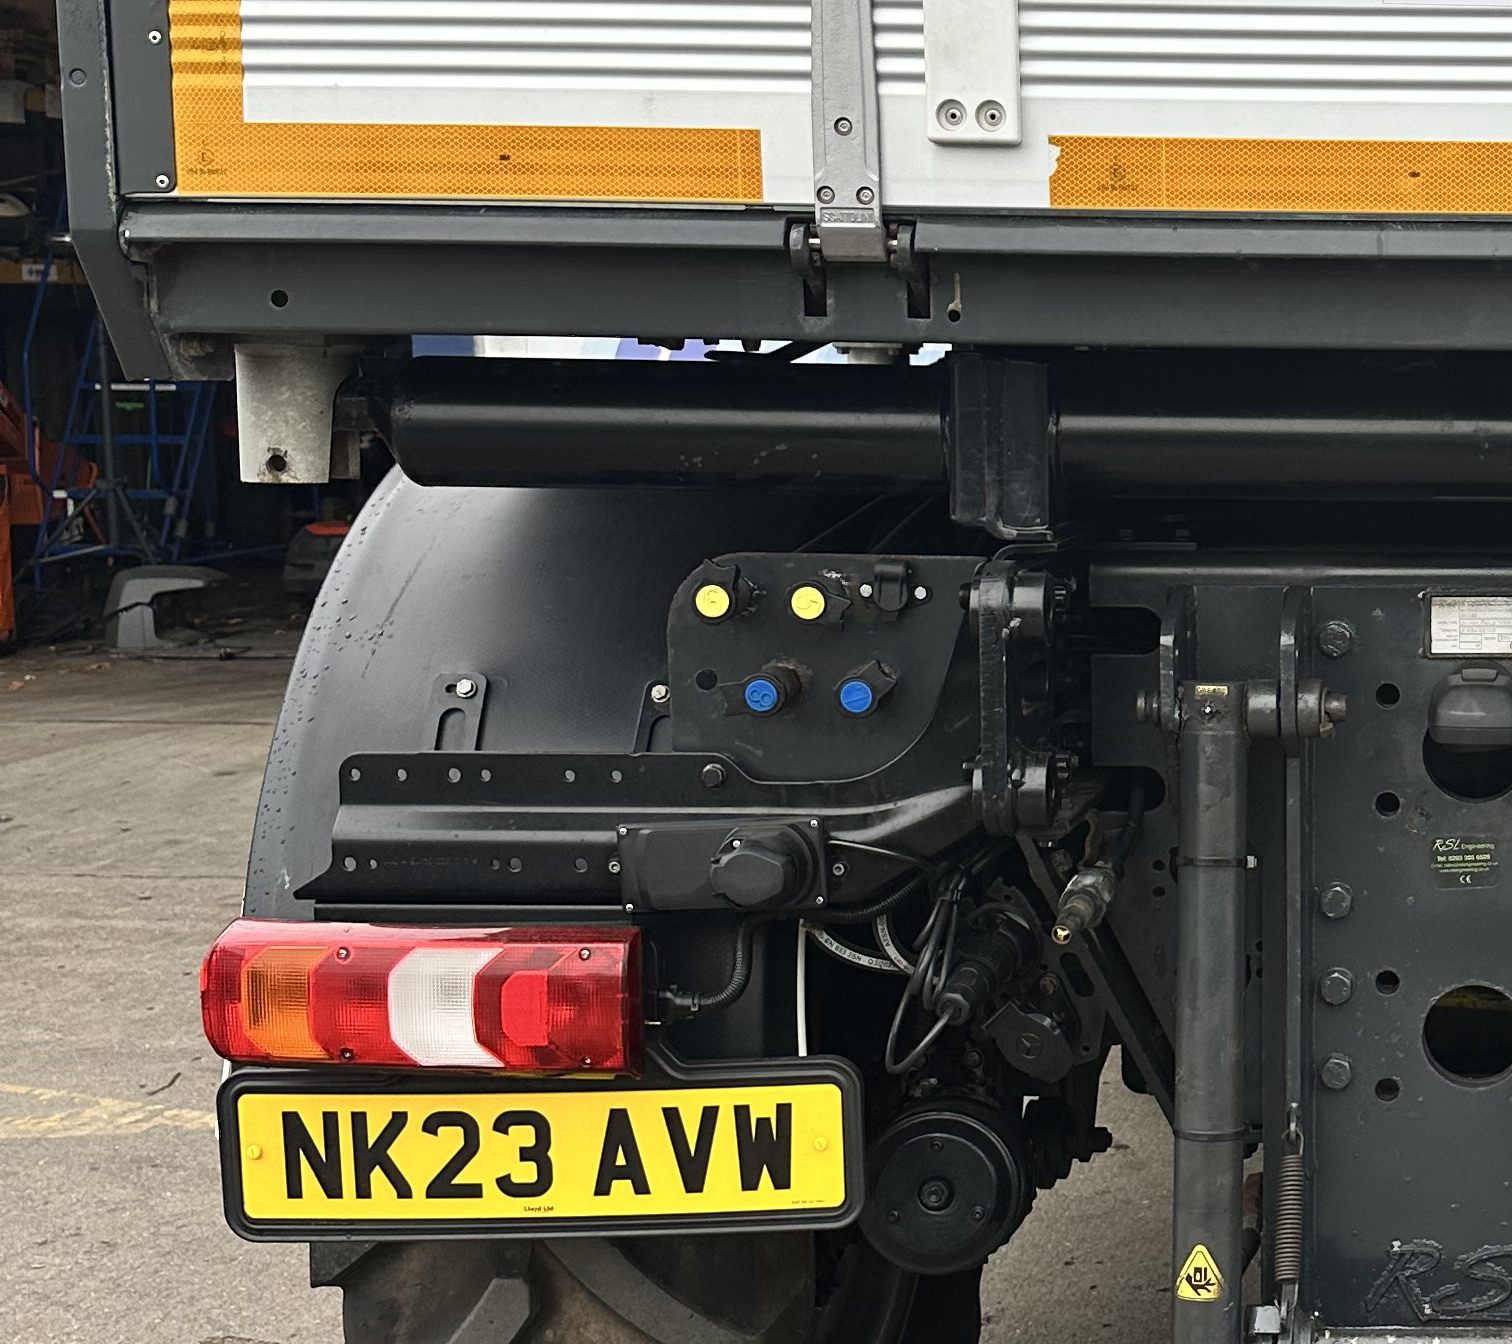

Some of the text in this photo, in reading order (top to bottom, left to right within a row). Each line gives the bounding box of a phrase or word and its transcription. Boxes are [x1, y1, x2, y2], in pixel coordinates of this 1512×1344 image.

[1432, 838, 1460, 852] RSL
[281, 1102, 793, 1200] NK23 AVW
